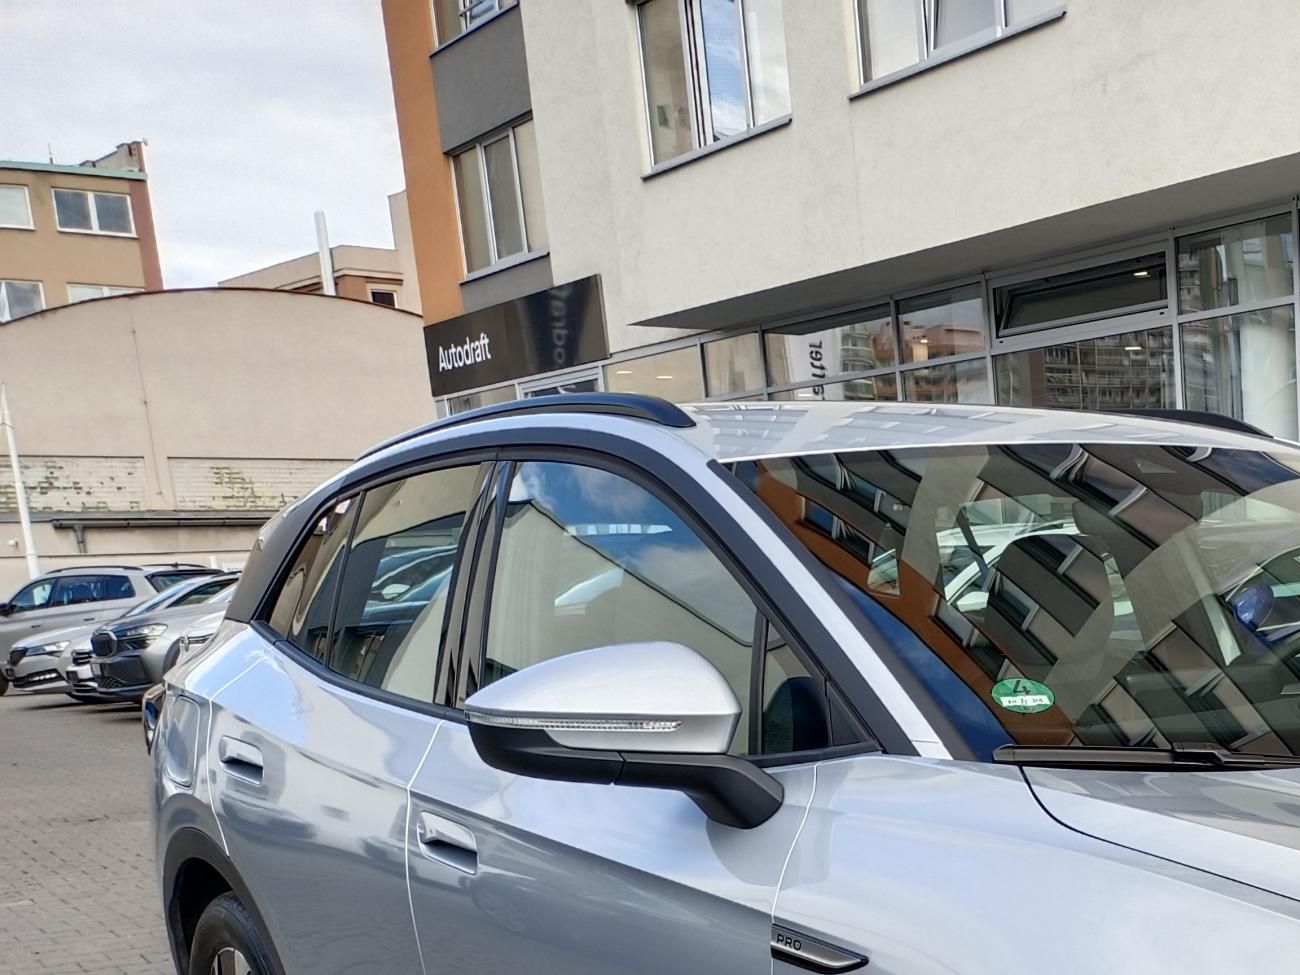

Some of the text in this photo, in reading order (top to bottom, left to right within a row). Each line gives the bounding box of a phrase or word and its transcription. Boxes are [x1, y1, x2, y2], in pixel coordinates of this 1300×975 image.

[438, 332, 491, 373] Autodraft
[1012, 679, 1031, 695] 4
[776, 933, 802, 951] PRO
